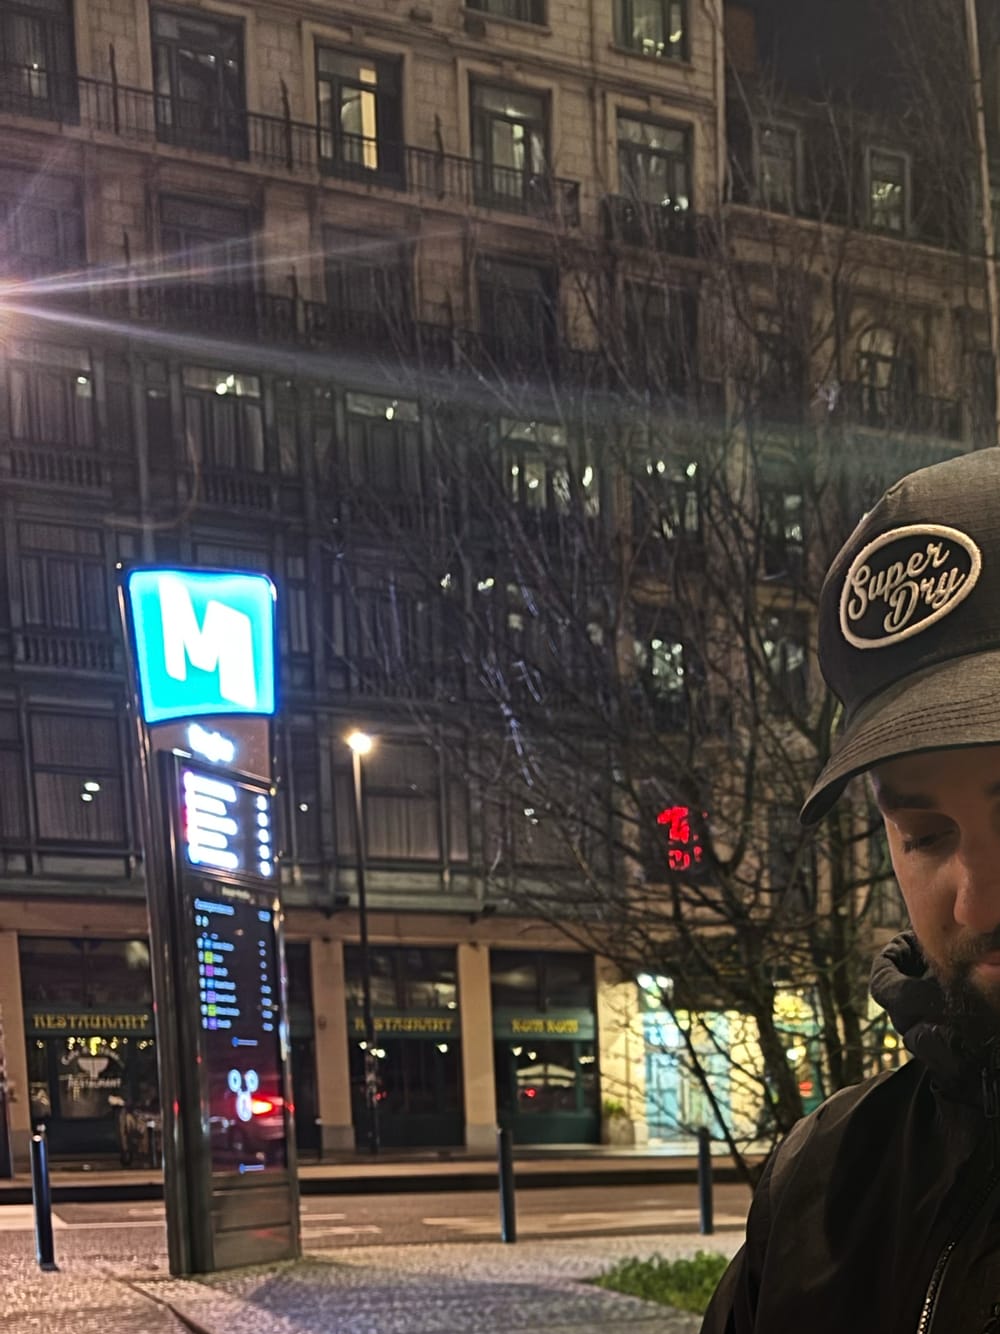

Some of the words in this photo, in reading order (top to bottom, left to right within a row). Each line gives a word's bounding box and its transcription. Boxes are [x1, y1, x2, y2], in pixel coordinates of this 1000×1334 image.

[848, 542, 950, 620] Super
[884, 567, 966, 633] Dry
[158, 573, 256, 709] M
[33, 1014, 147, 1030] RESTAURANT
[354, 1017, 452, 1032] RSTAURANT
